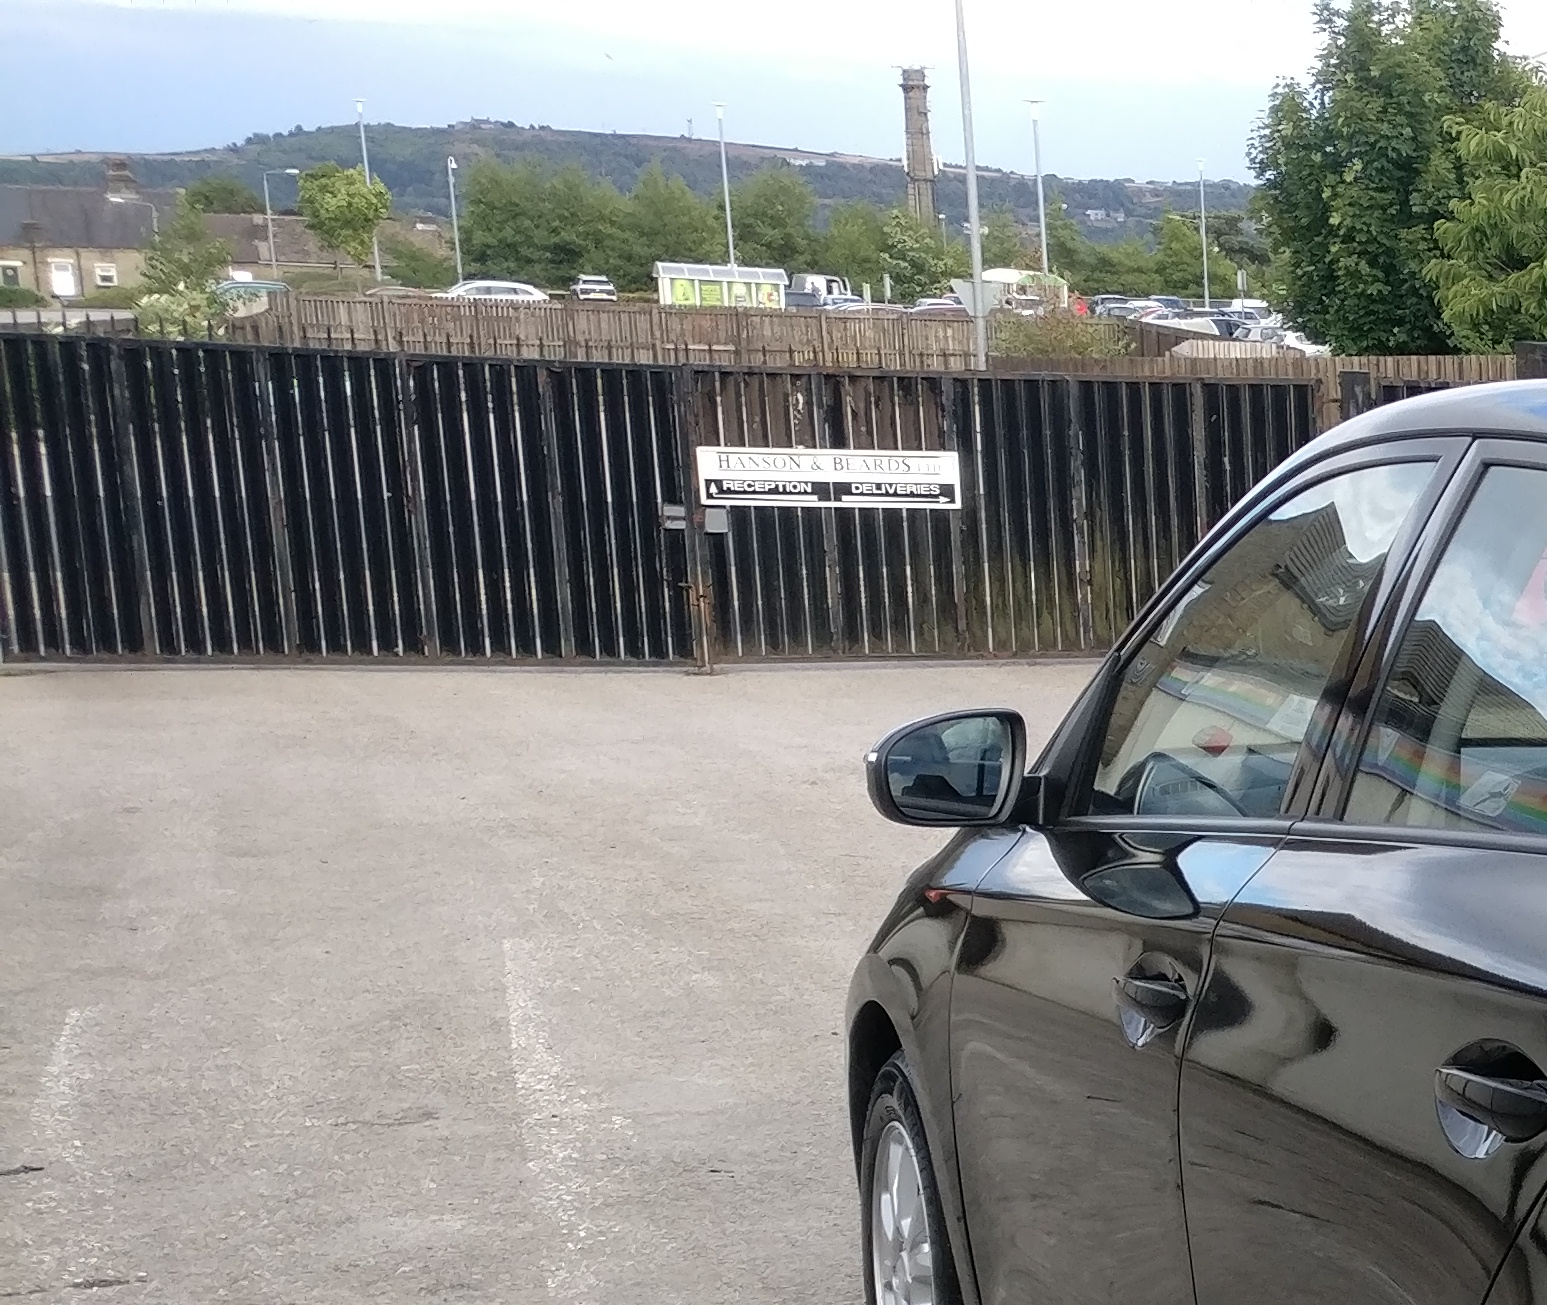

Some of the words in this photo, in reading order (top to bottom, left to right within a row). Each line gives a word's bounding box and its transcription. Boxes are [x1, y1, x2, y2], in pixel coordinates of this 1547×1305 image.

[718, 454, 802, 471] HANSON
[809, 456, 825, 471] &
[832, 456, 911, 473] BEARDS
[722, 480, 812, 493] RECEPTION
[851, 482, 941, 495] DELIVERIES
